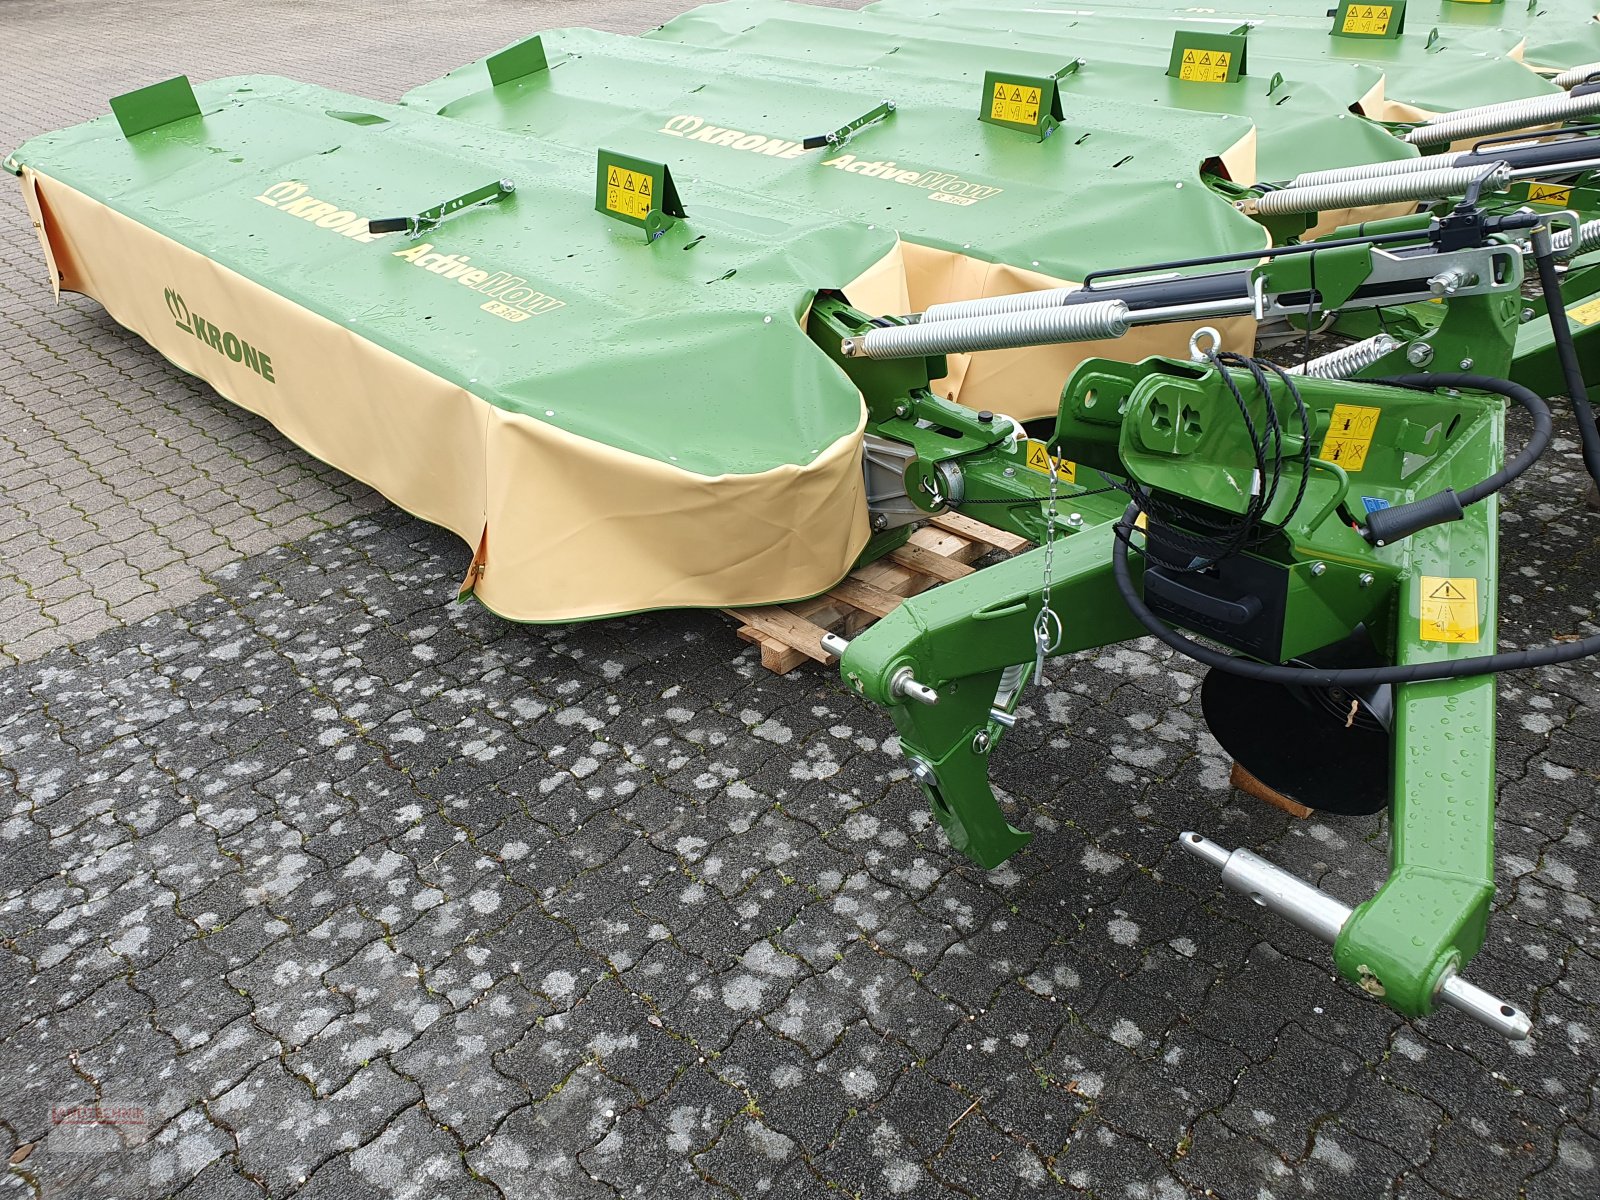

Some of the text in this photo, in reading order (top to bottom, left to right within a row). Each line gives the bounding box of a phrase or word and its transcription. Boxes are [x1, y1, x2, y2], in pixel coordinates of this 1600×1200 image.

[821, 154, 1004, 200] ActiveMow
[392, 243, 566, 315] ActiveMow
[486, 303, 524, 319] R 360
[192, 312, 276, 384] KRONE
